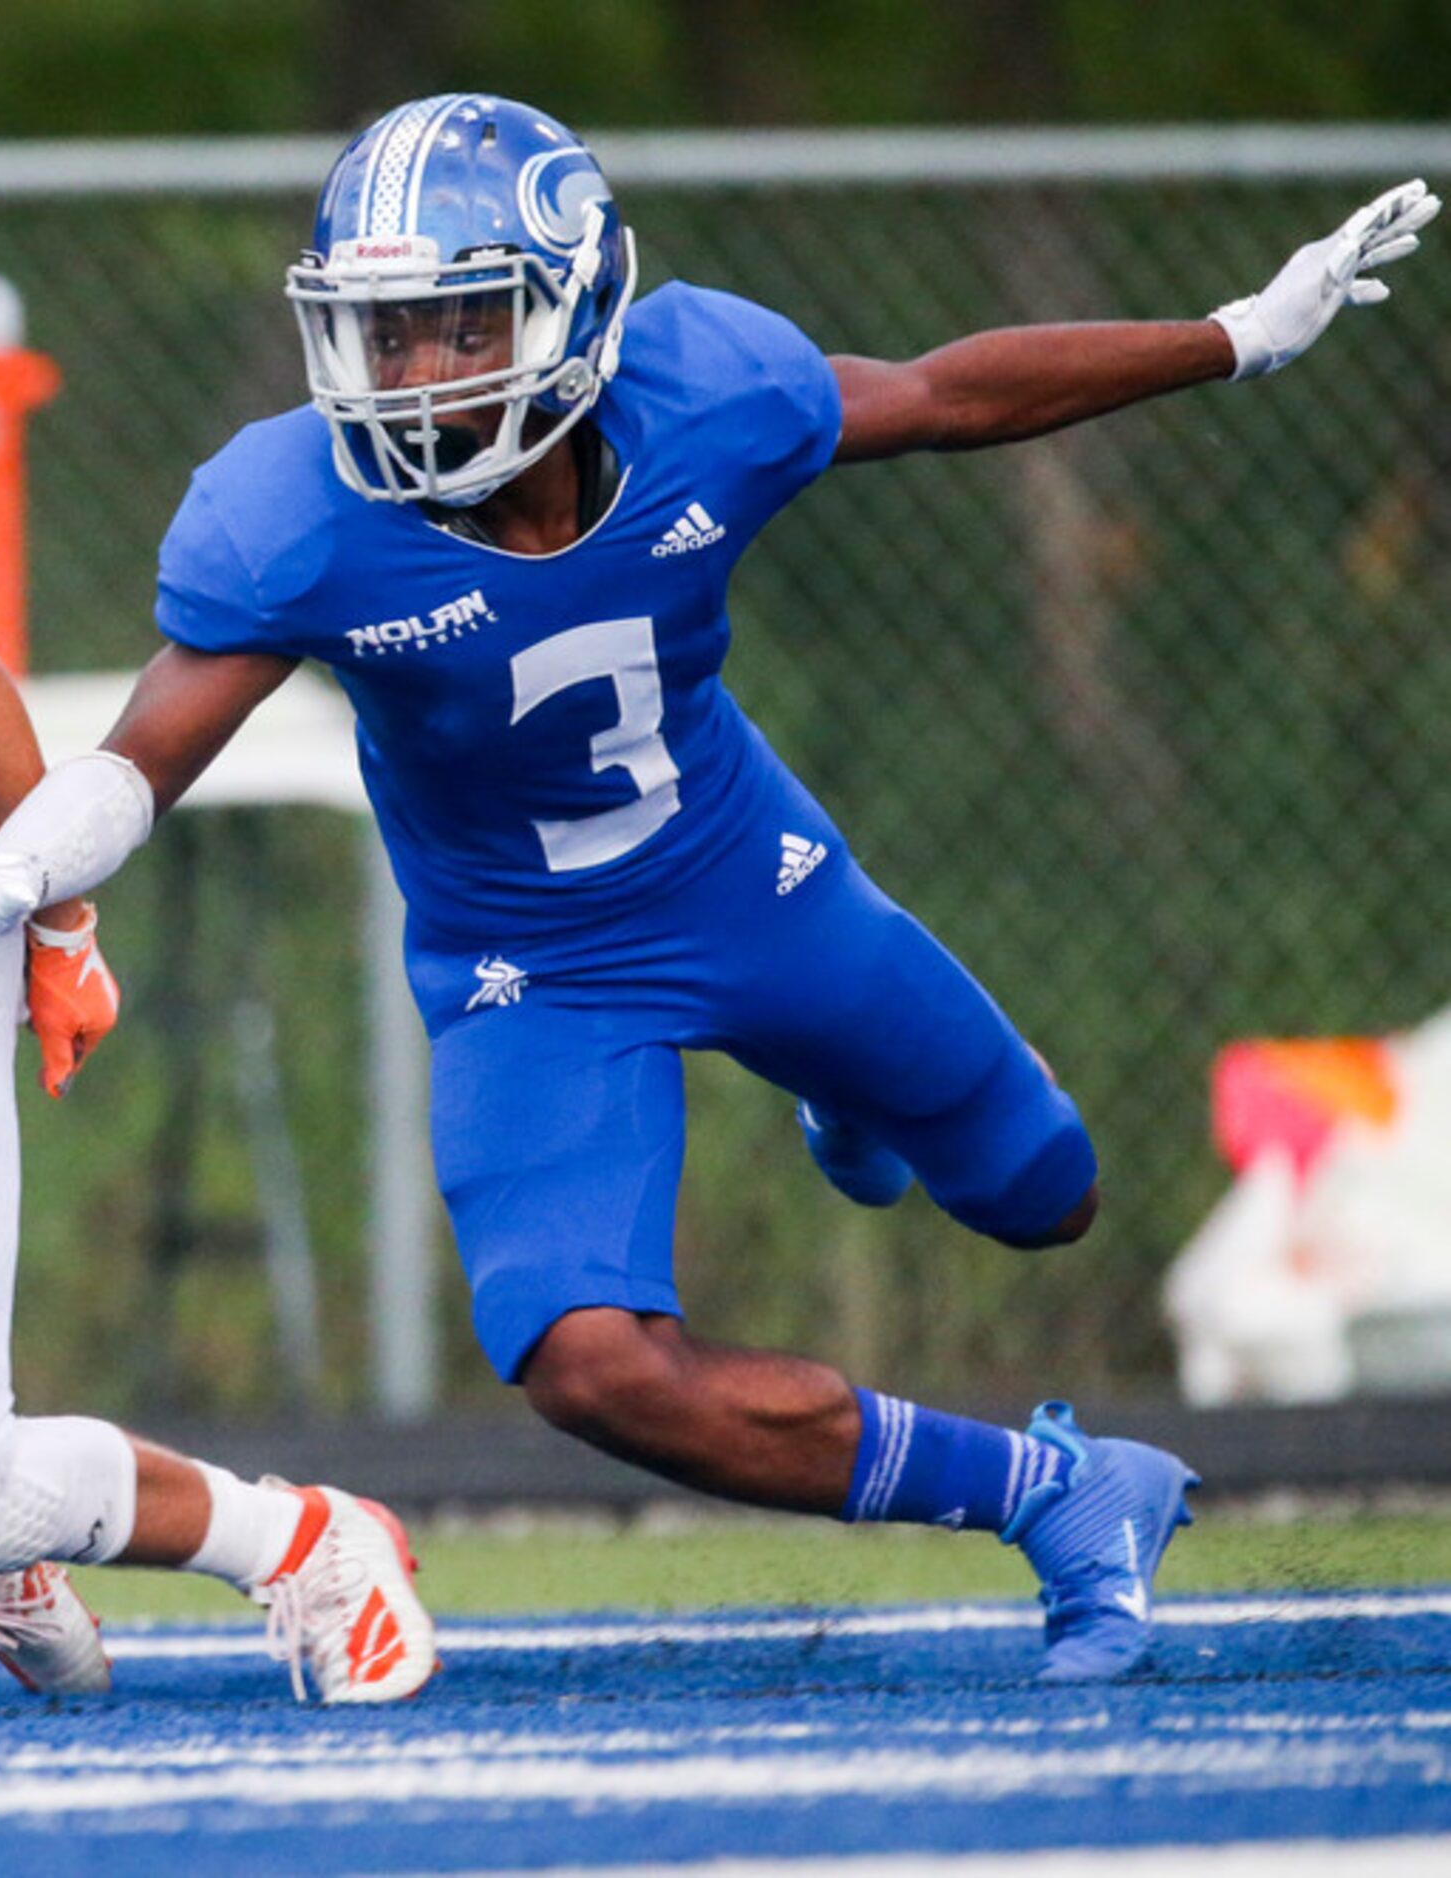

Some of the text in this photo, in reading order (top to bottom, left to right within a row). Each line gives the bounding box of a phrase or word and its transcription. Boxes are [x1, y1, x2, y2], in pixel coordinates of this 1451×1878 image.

[651, 524, 726, 558] adidas
[345, 589, 488, 648] NOLAN
[510, 616, 682, 873] 3
[776, 842, 828, 896] adidas
